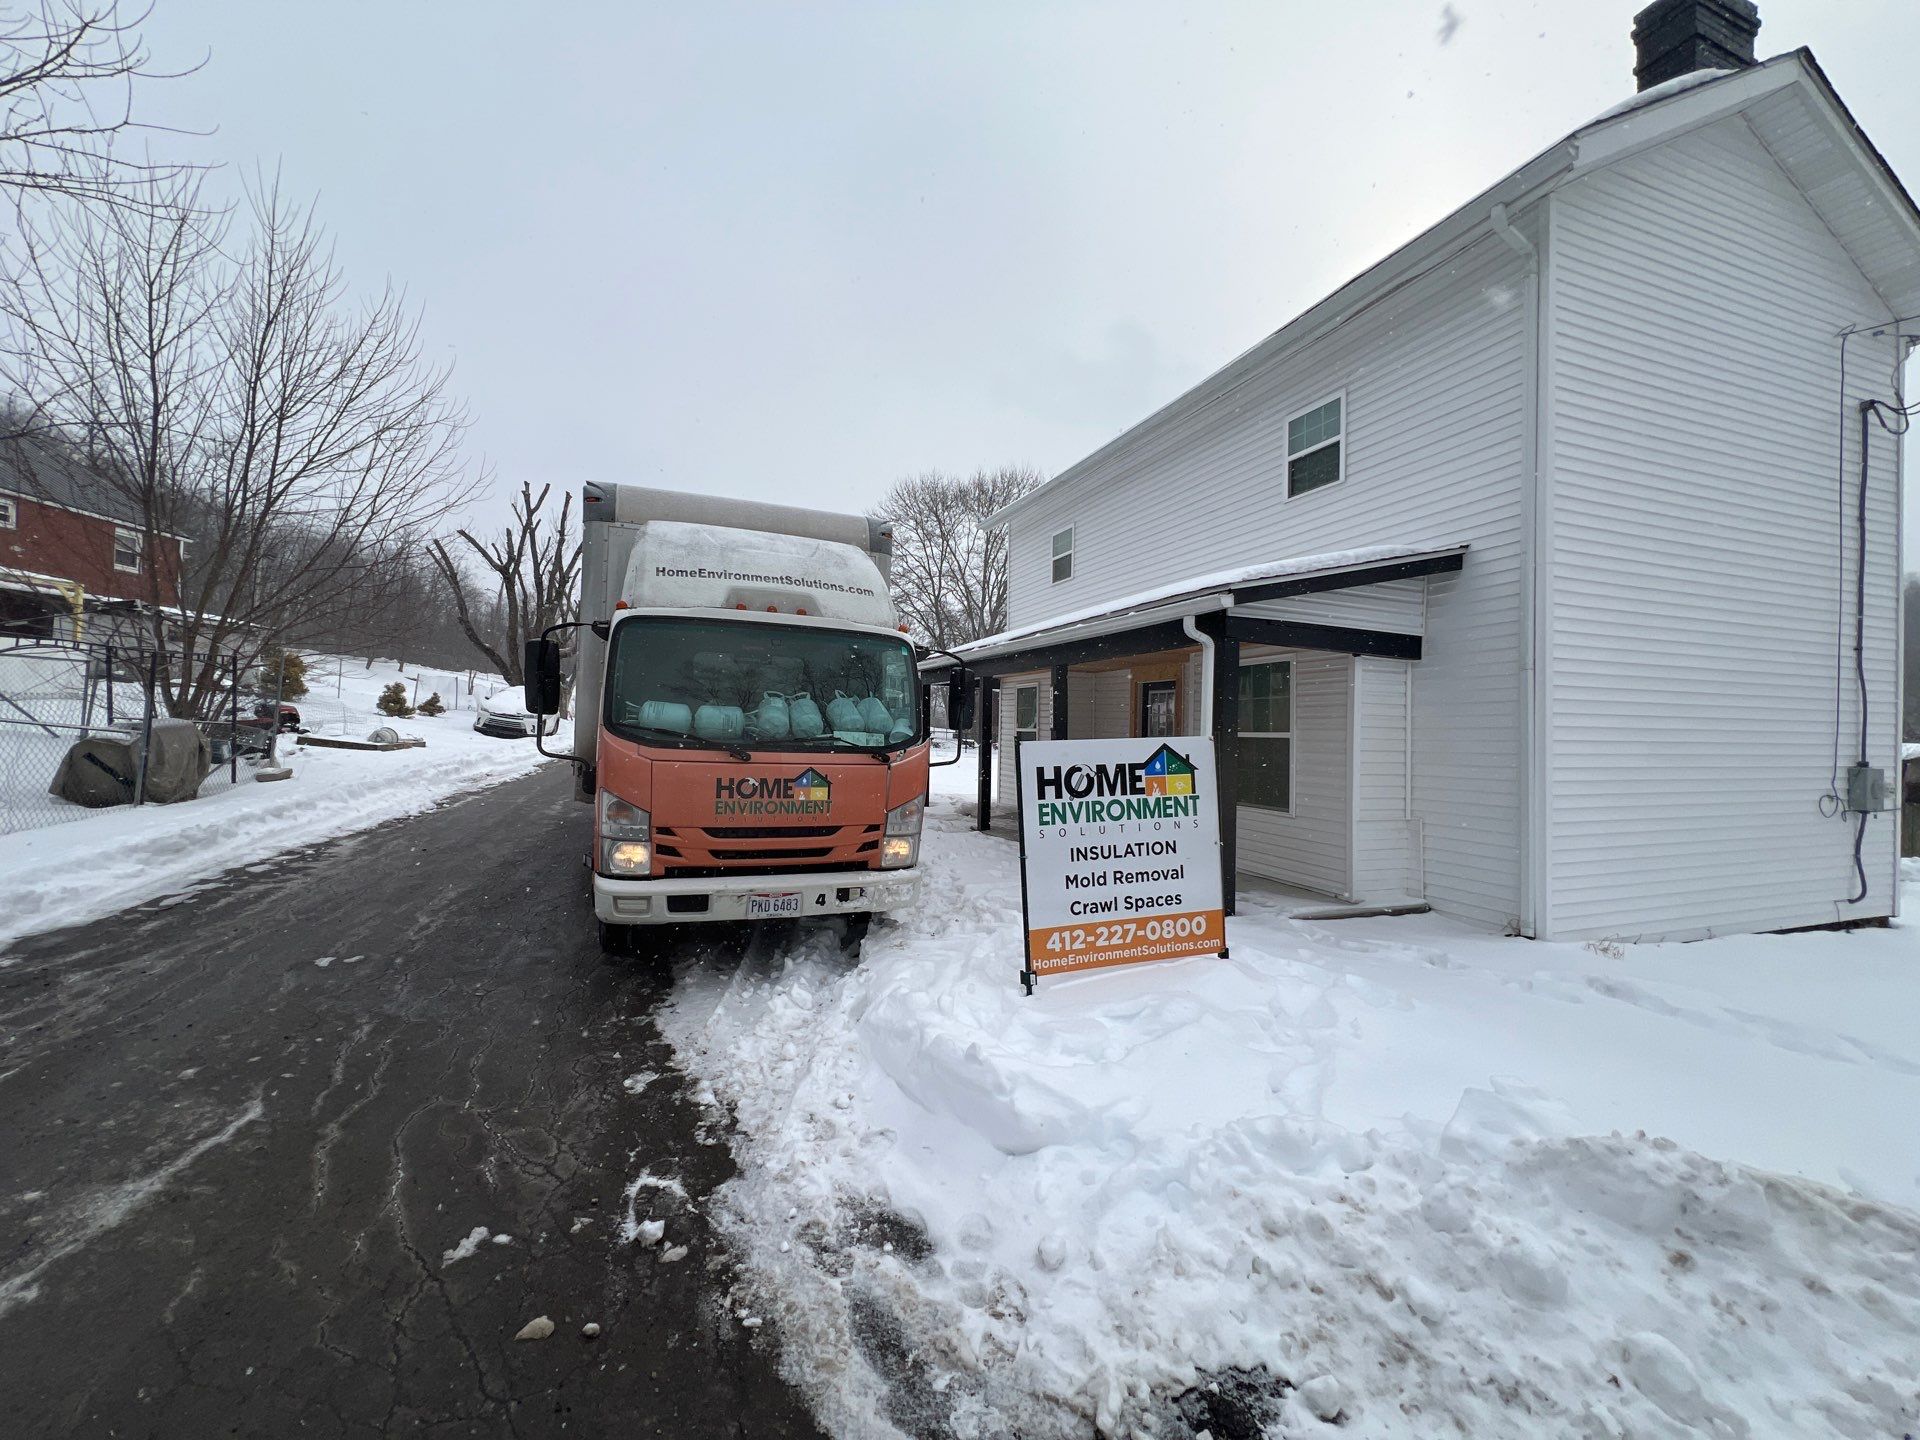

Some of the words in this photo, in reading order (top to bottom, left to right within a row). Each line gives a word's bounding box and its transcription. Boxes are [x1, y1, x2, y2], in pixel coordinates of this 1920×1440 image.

[655, 566, 875, 597] HomeEnvironmentSolutions.com
[715, 777, 795, 799] HOME
[1036, 763, 1146, 801] HOME
[715, 800, 832, 815] ENVIRONMENT
[1038, 795, 1200, 826] ENVIRONMENT
[1039, 819, 1199, 839] SOLUTIONS
[1070, 840, 1177, 862] INSULATION
[1065, 872, 1107, 889] Mold
[1113, 865, 1184, 885] Removal
[751, 900, 770, 913] PKD
[773, 899, 798, 911] 6483
[815, 894, 826, 906] 4
[1070, 897, 1118, 915] Crawl
[1124, 893, 1182, 913] Spaces
[1046, 915, 1207, 952] 412-227-0800
[1033, 938, 1221, 970] HomeEnvironmentSolutions.com
